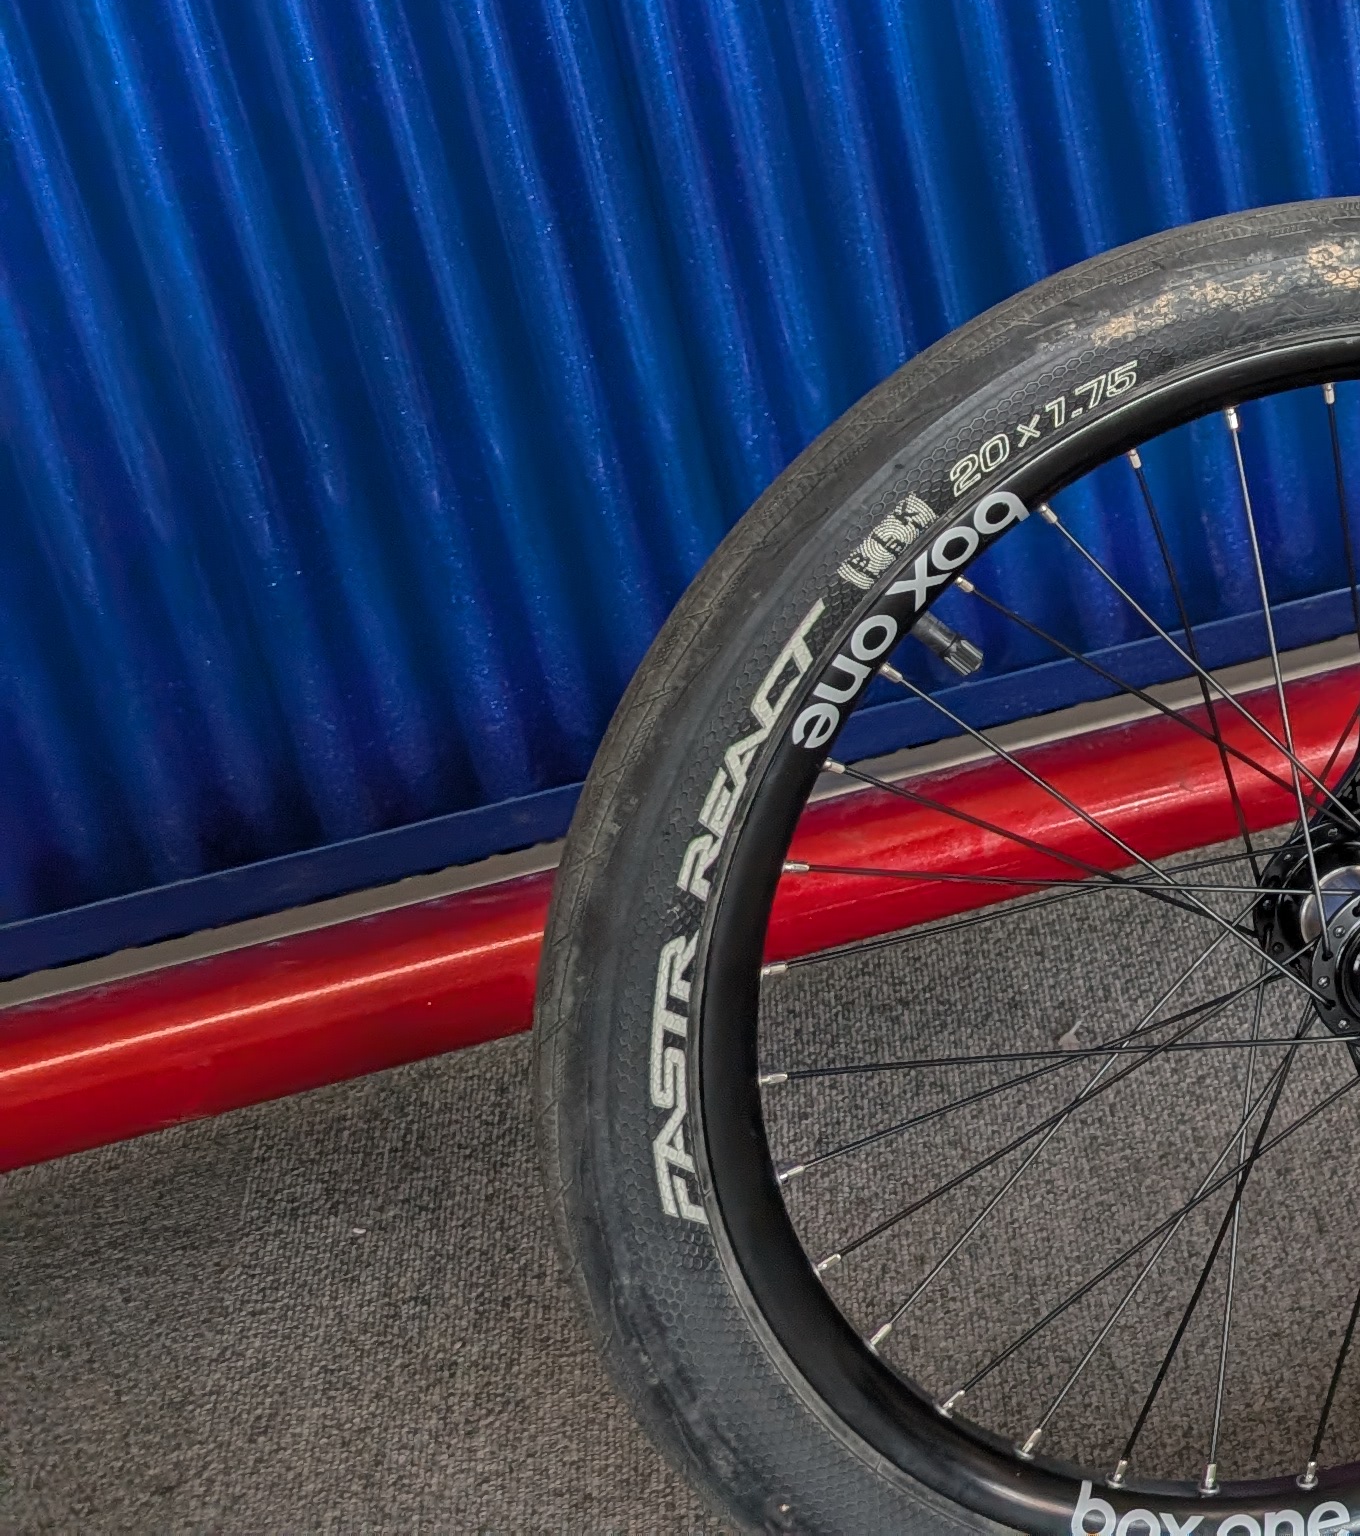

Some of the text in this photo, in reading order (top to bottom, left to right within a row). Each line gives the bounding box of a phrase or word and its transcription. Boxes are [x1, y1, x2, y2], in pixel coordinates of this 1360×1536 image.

[792, 490, 1031, 750] box one
[649, 597, 826, 1225] FASTR REACT
